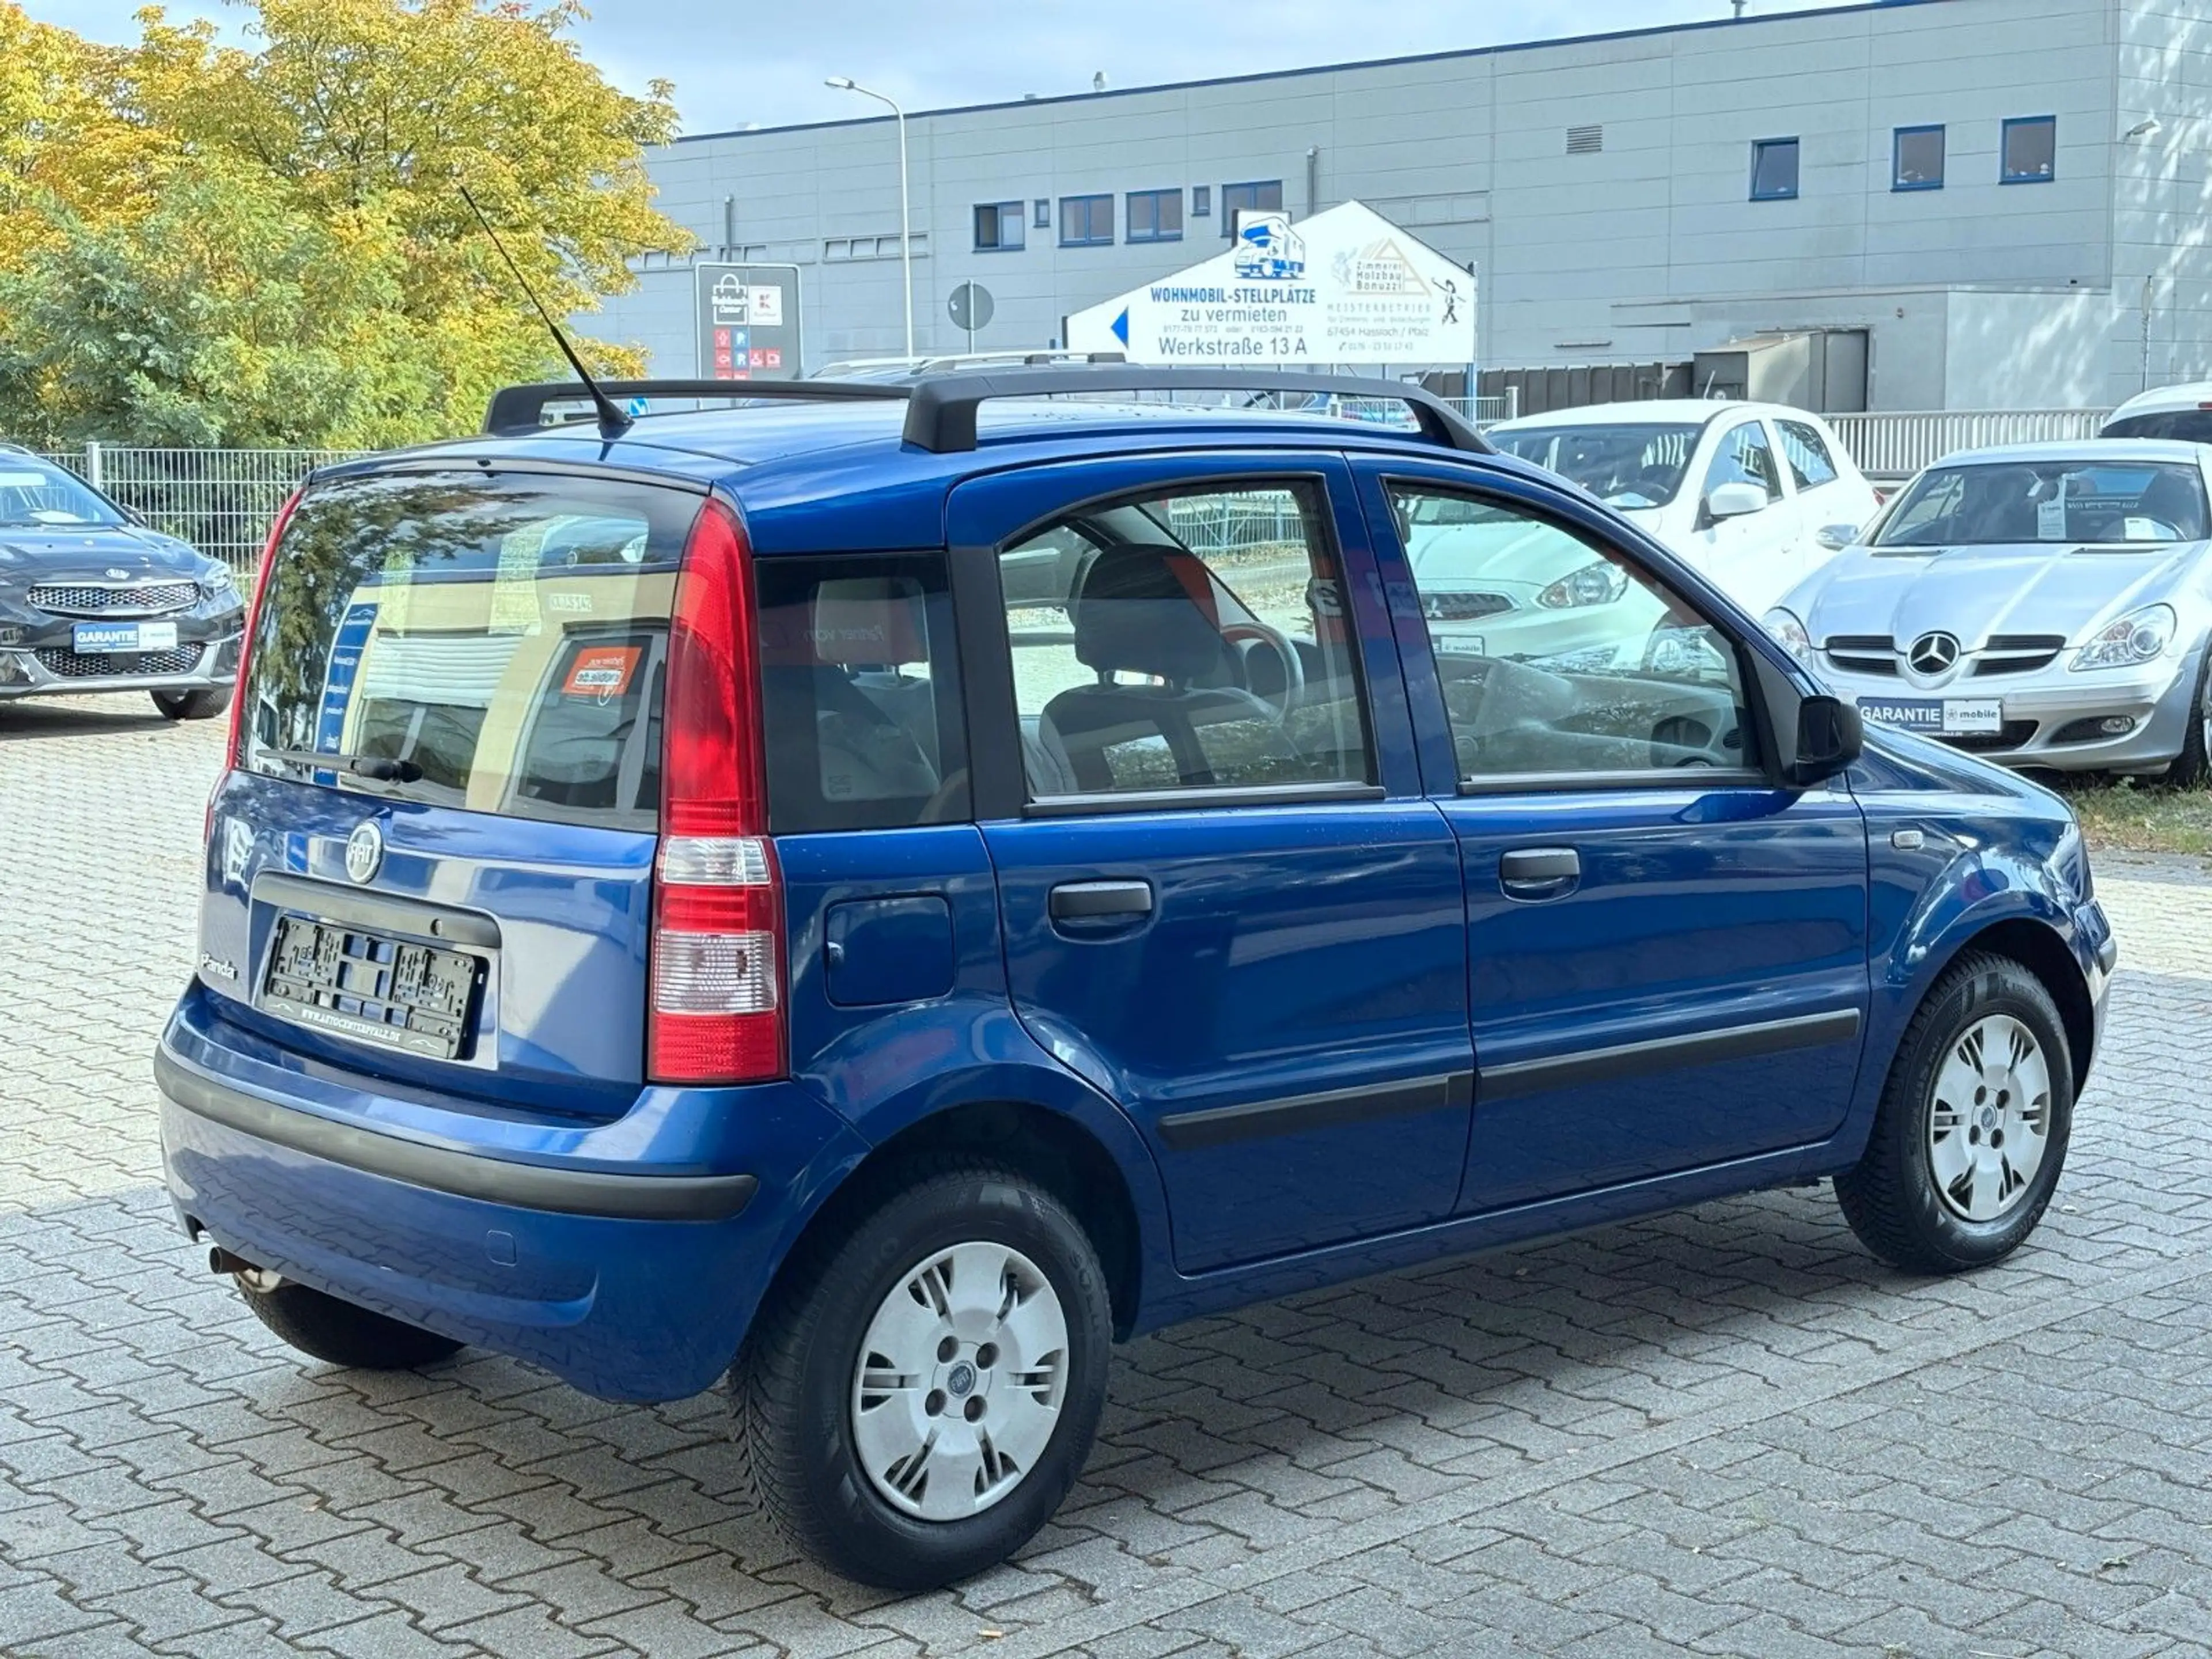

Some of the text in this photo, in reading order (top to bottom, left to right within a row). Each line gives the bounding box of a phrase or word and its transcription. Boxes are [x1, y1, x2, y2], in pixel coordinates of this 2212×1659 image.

[1357, 271, 1402, 281] Holzbau
[1150, 284, 1316, 304] WOHNMOBIL-STELLPLÄTZE
[1181, 306, 1287, 322] zu vermieten
[1158, 336, 1308, 355] Werkstraße 13 A
[77, 630, 138, 642] GARANTIE
[1860, 706, 1997, 722] GARANTIE mobile
[349, 842, 373, 864] FIAT
[200, 953, 236, 980] Panda
[951, 1369, 969, 1392] FIAT
